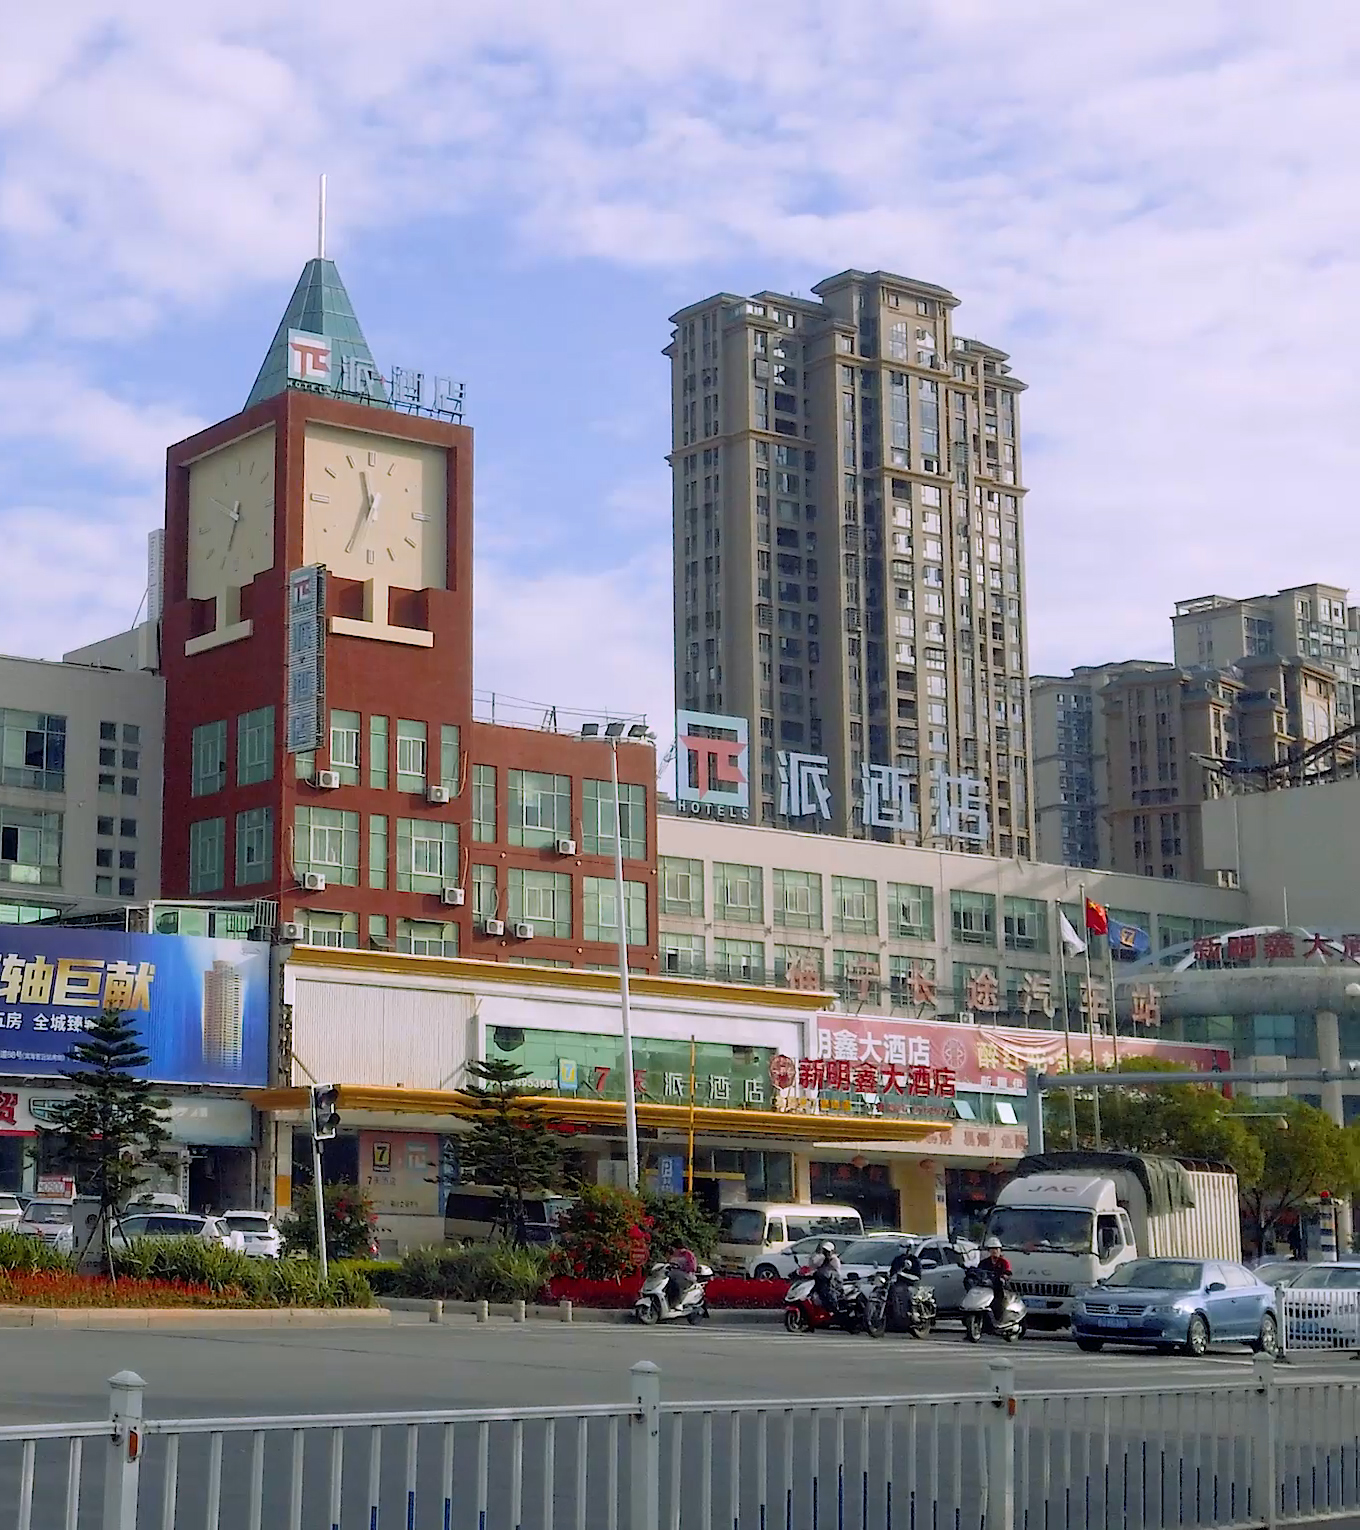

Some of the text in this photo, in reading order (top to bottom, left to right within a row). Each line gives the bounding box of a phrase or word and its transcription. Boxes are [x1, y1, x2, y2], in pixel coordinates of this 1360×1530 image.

[678, 799, 749, 820] HOTELS
[799, 1056, 956, 1098] 新明鑫大酒店
[1028, 1185, 1077, 1193] JAC
